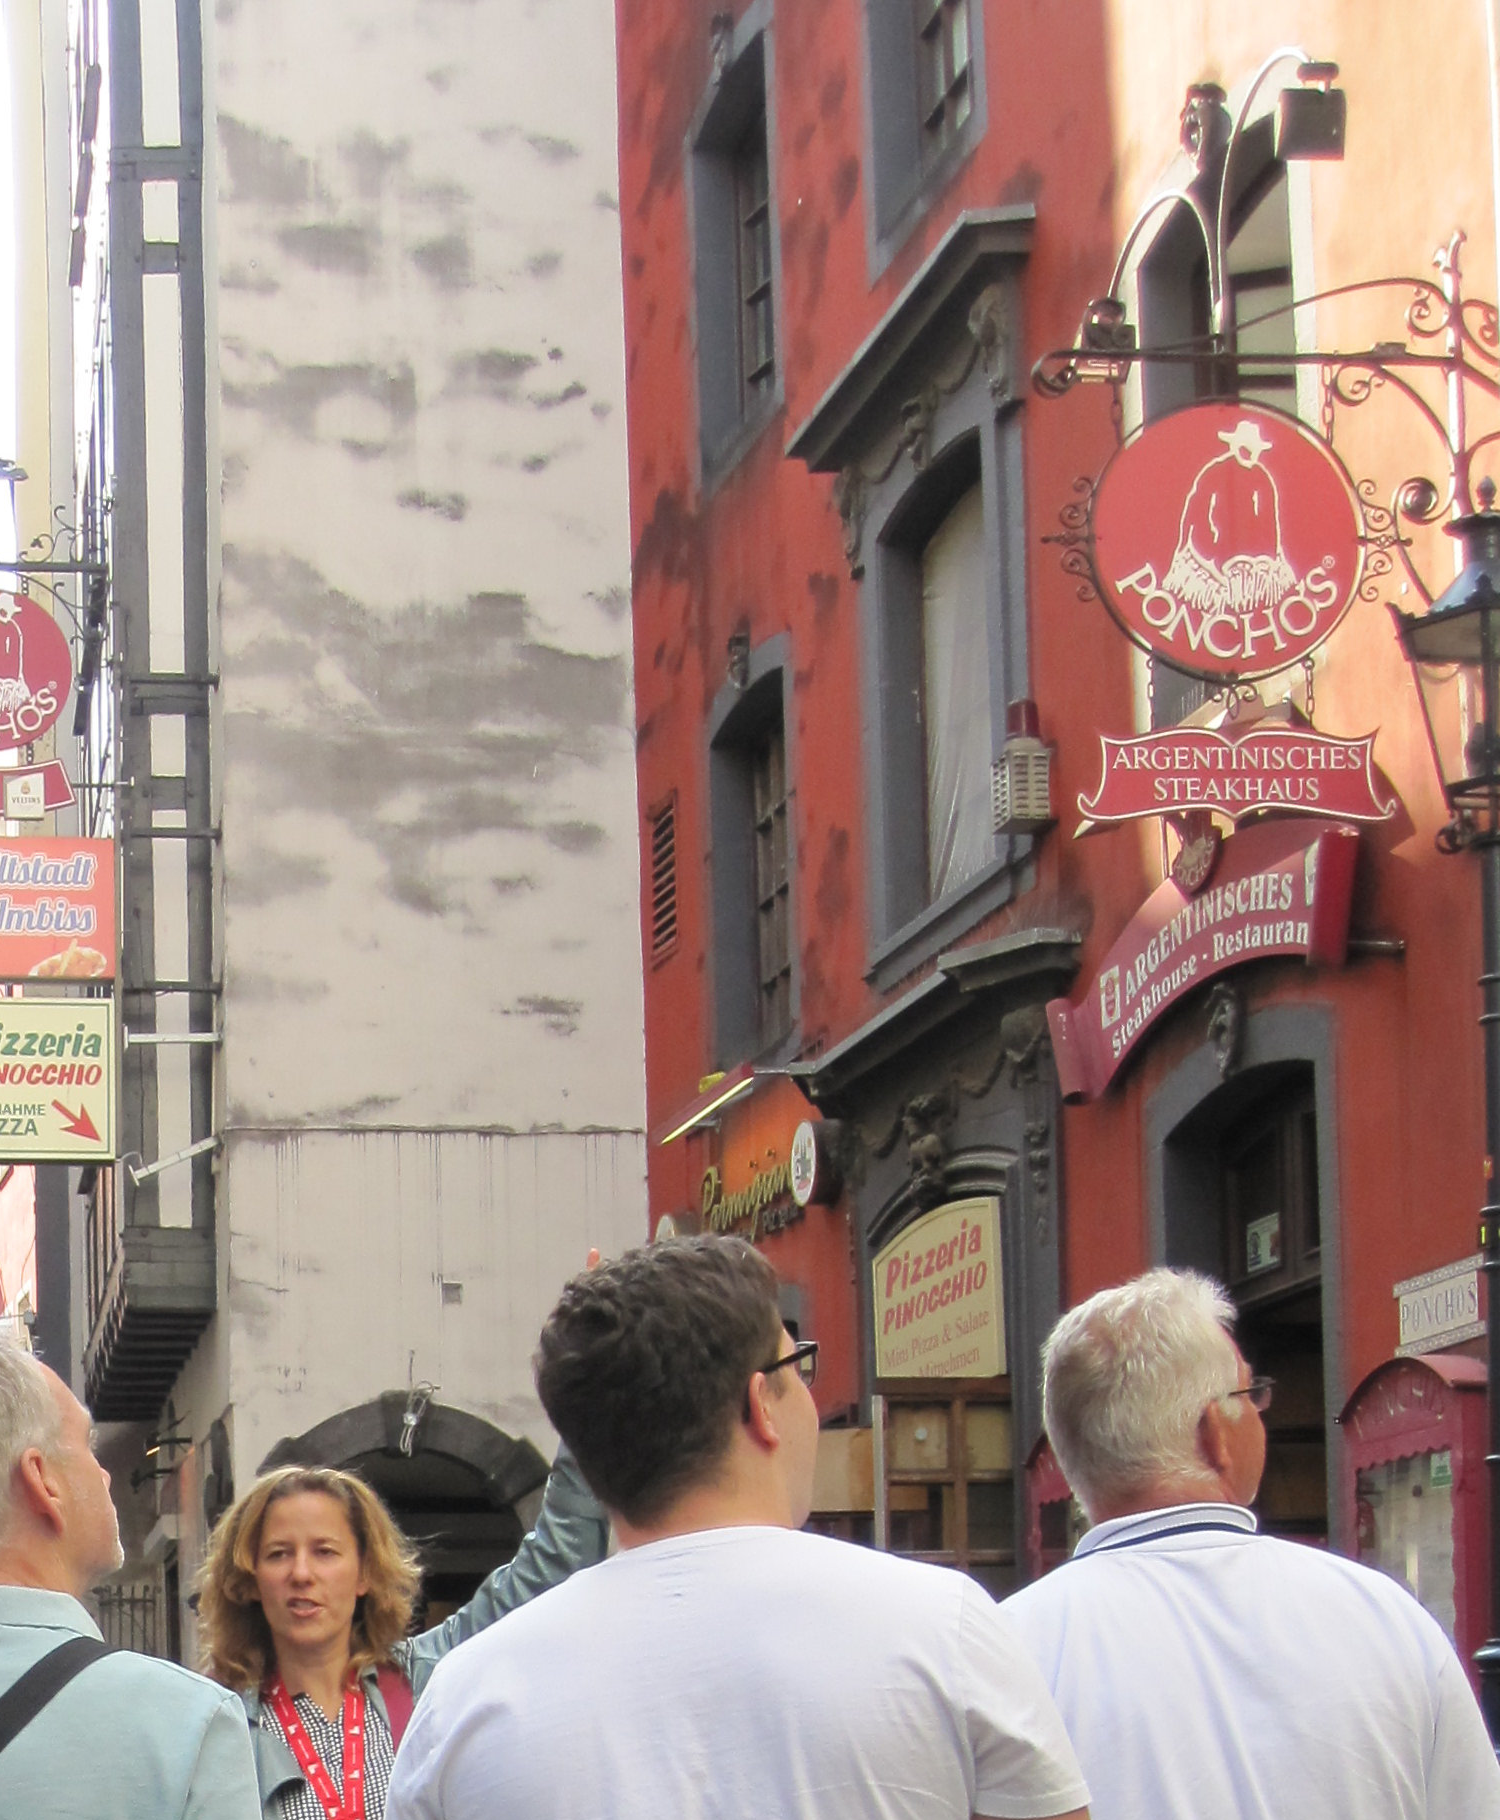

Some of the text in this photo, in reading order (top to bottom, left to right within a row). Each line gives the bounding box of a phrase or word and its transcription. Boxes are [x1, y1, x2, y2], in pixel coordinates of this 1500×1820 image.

[1112, 745, 1362, 770] ARGENTINISCHES
[1153, 777, 1320, 801] STEAKHAUS
[1126, 872, 1294, 1005] ARGENTINISCHES
[885, 1218, 982, 1299] Pizzeria
[883, 1260, 988, 1336] PINOCCHIO
[1401, 1280, 1478, 1336] PONCHOS
[911, 1332, 939, 1359] Pizza
[942, 1322, 952, 1342] &
[956, 1309, 990, 1338] Salate
